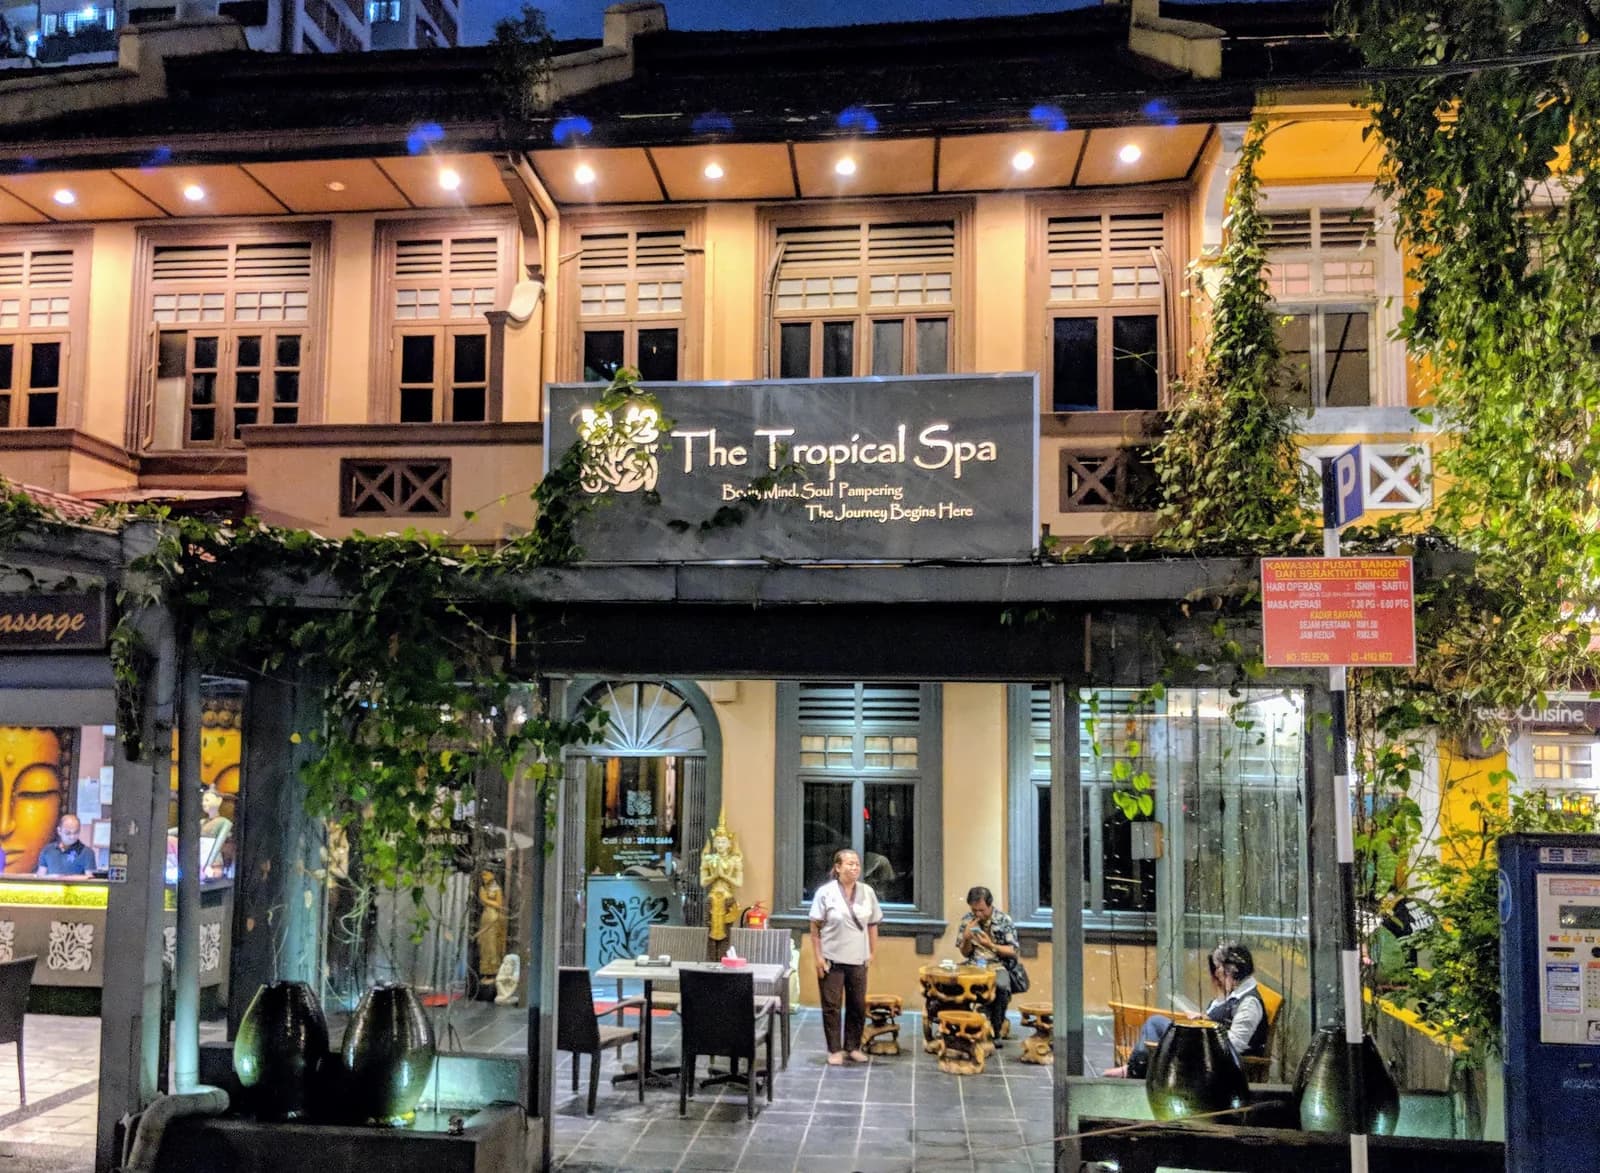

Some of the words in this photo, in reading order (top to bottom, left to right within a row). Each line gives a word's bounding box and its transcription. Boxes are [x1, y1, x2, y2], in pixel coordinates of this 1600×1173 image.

[670, 427, 748, 474] The
[754, 423, 906, 481] Tropical
[913, 423, 998, 480] Spa
[800, 482, 834, 500] Soul
[839, 481, 904, 502] Pampering
[1337, 453, 1356, 524] P
[805, 503, 834, 521] The
[835, 503, 888, 523] Journey
[890, 503, 936, 522] Begins
[939, 502, 974, 520] Here
[1265, 561, 1320, 570] KAWASAN
[1322, 560, 1358, 569] PUSAT
[1361, 559, 1407, 569] BANDAR
[1275, 569, 1297, 578] DAN
[1299, 568, 1362, 578] BERAKTIVITI
[1364, 568, 1399, 578] TINGGI
[1266, 582, 1286, 592] HARI
[1286, 581, 1322, 592] OPERASI
[1382, 580, 1409, 591] SABTU
[1267, 600, 1288, 609] MASA
[1288, 599, 1322, 609] OPERASI
[1365, 599, 1376, 609] PG
[1394, 599, 1409, 609] PTG
